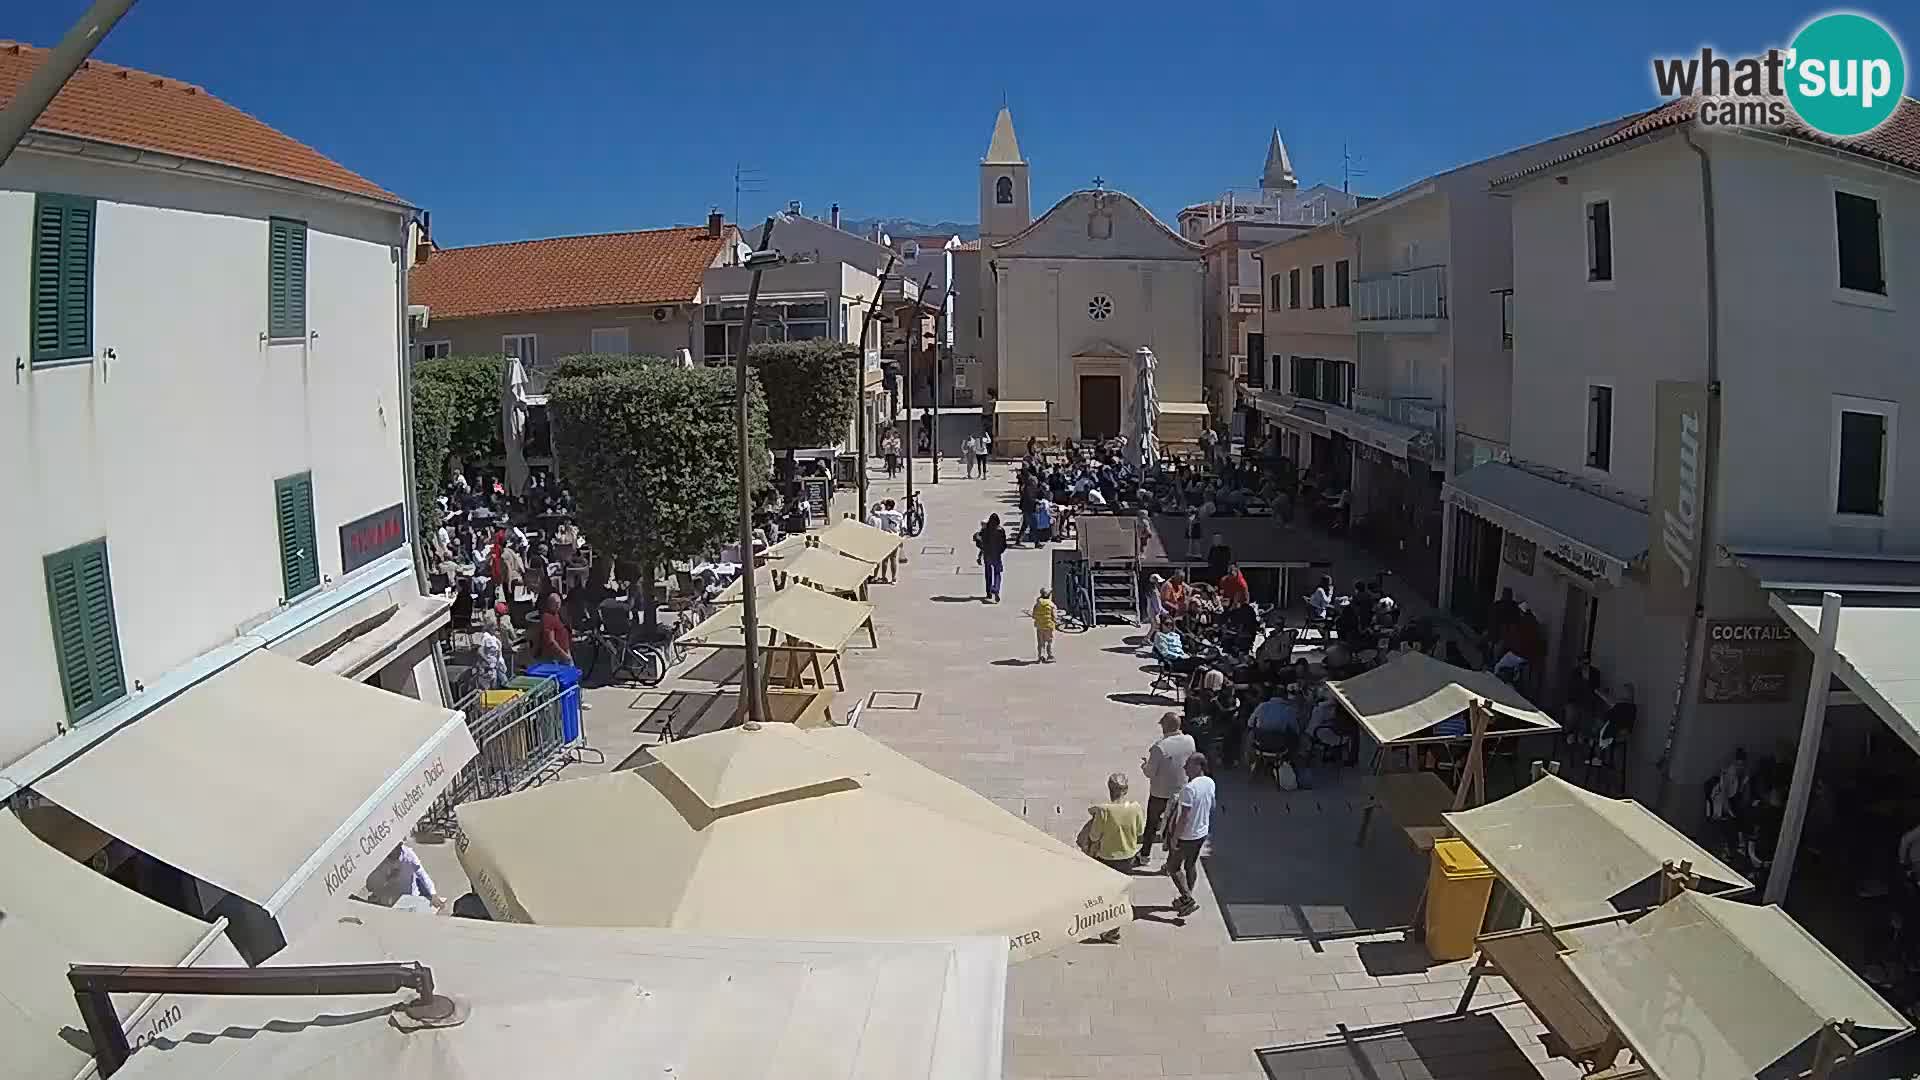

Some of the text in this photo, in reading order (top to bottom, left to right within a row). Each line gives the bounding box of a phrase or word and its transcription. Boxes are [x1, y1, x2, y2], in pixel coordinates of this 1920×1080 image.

[1712, 626, 1792, 640] COCKTAILS
[359, 820, 391, 856] Cakes
[392, 784, 424, 822] Kuchen
[1067, 903, 1126, 936] Jamnica
[1009, 930, 1041, 951] ATER
